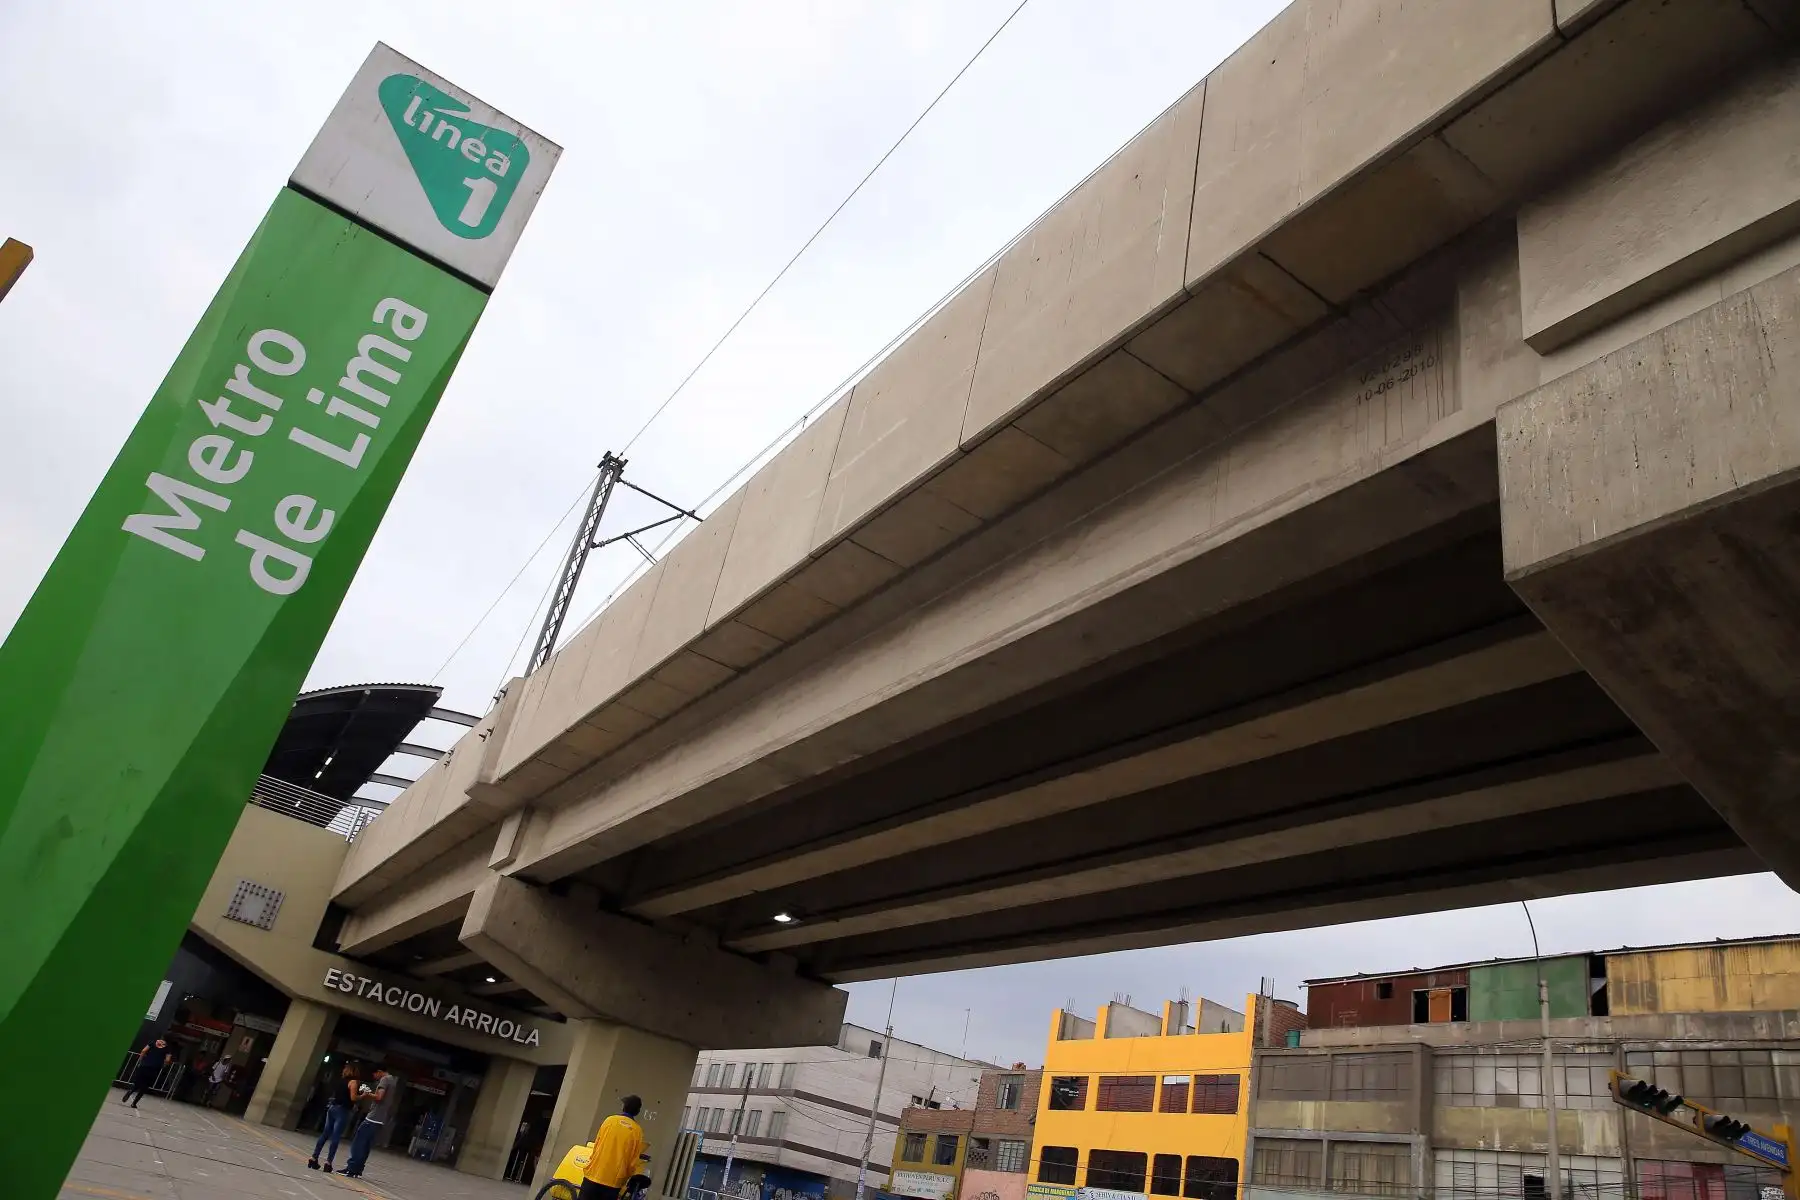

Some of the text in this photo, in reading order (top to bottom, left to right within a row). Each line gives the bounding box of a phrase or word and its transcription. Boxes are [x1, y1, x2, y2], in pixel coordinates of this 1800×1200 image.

[457, 177, 498, 228] 1
[121, 328, 306, 562] Metro
[235, 297, 428, 596] de Lima
[323, 967, 540, 1047] ESTACION ARRIOLA
